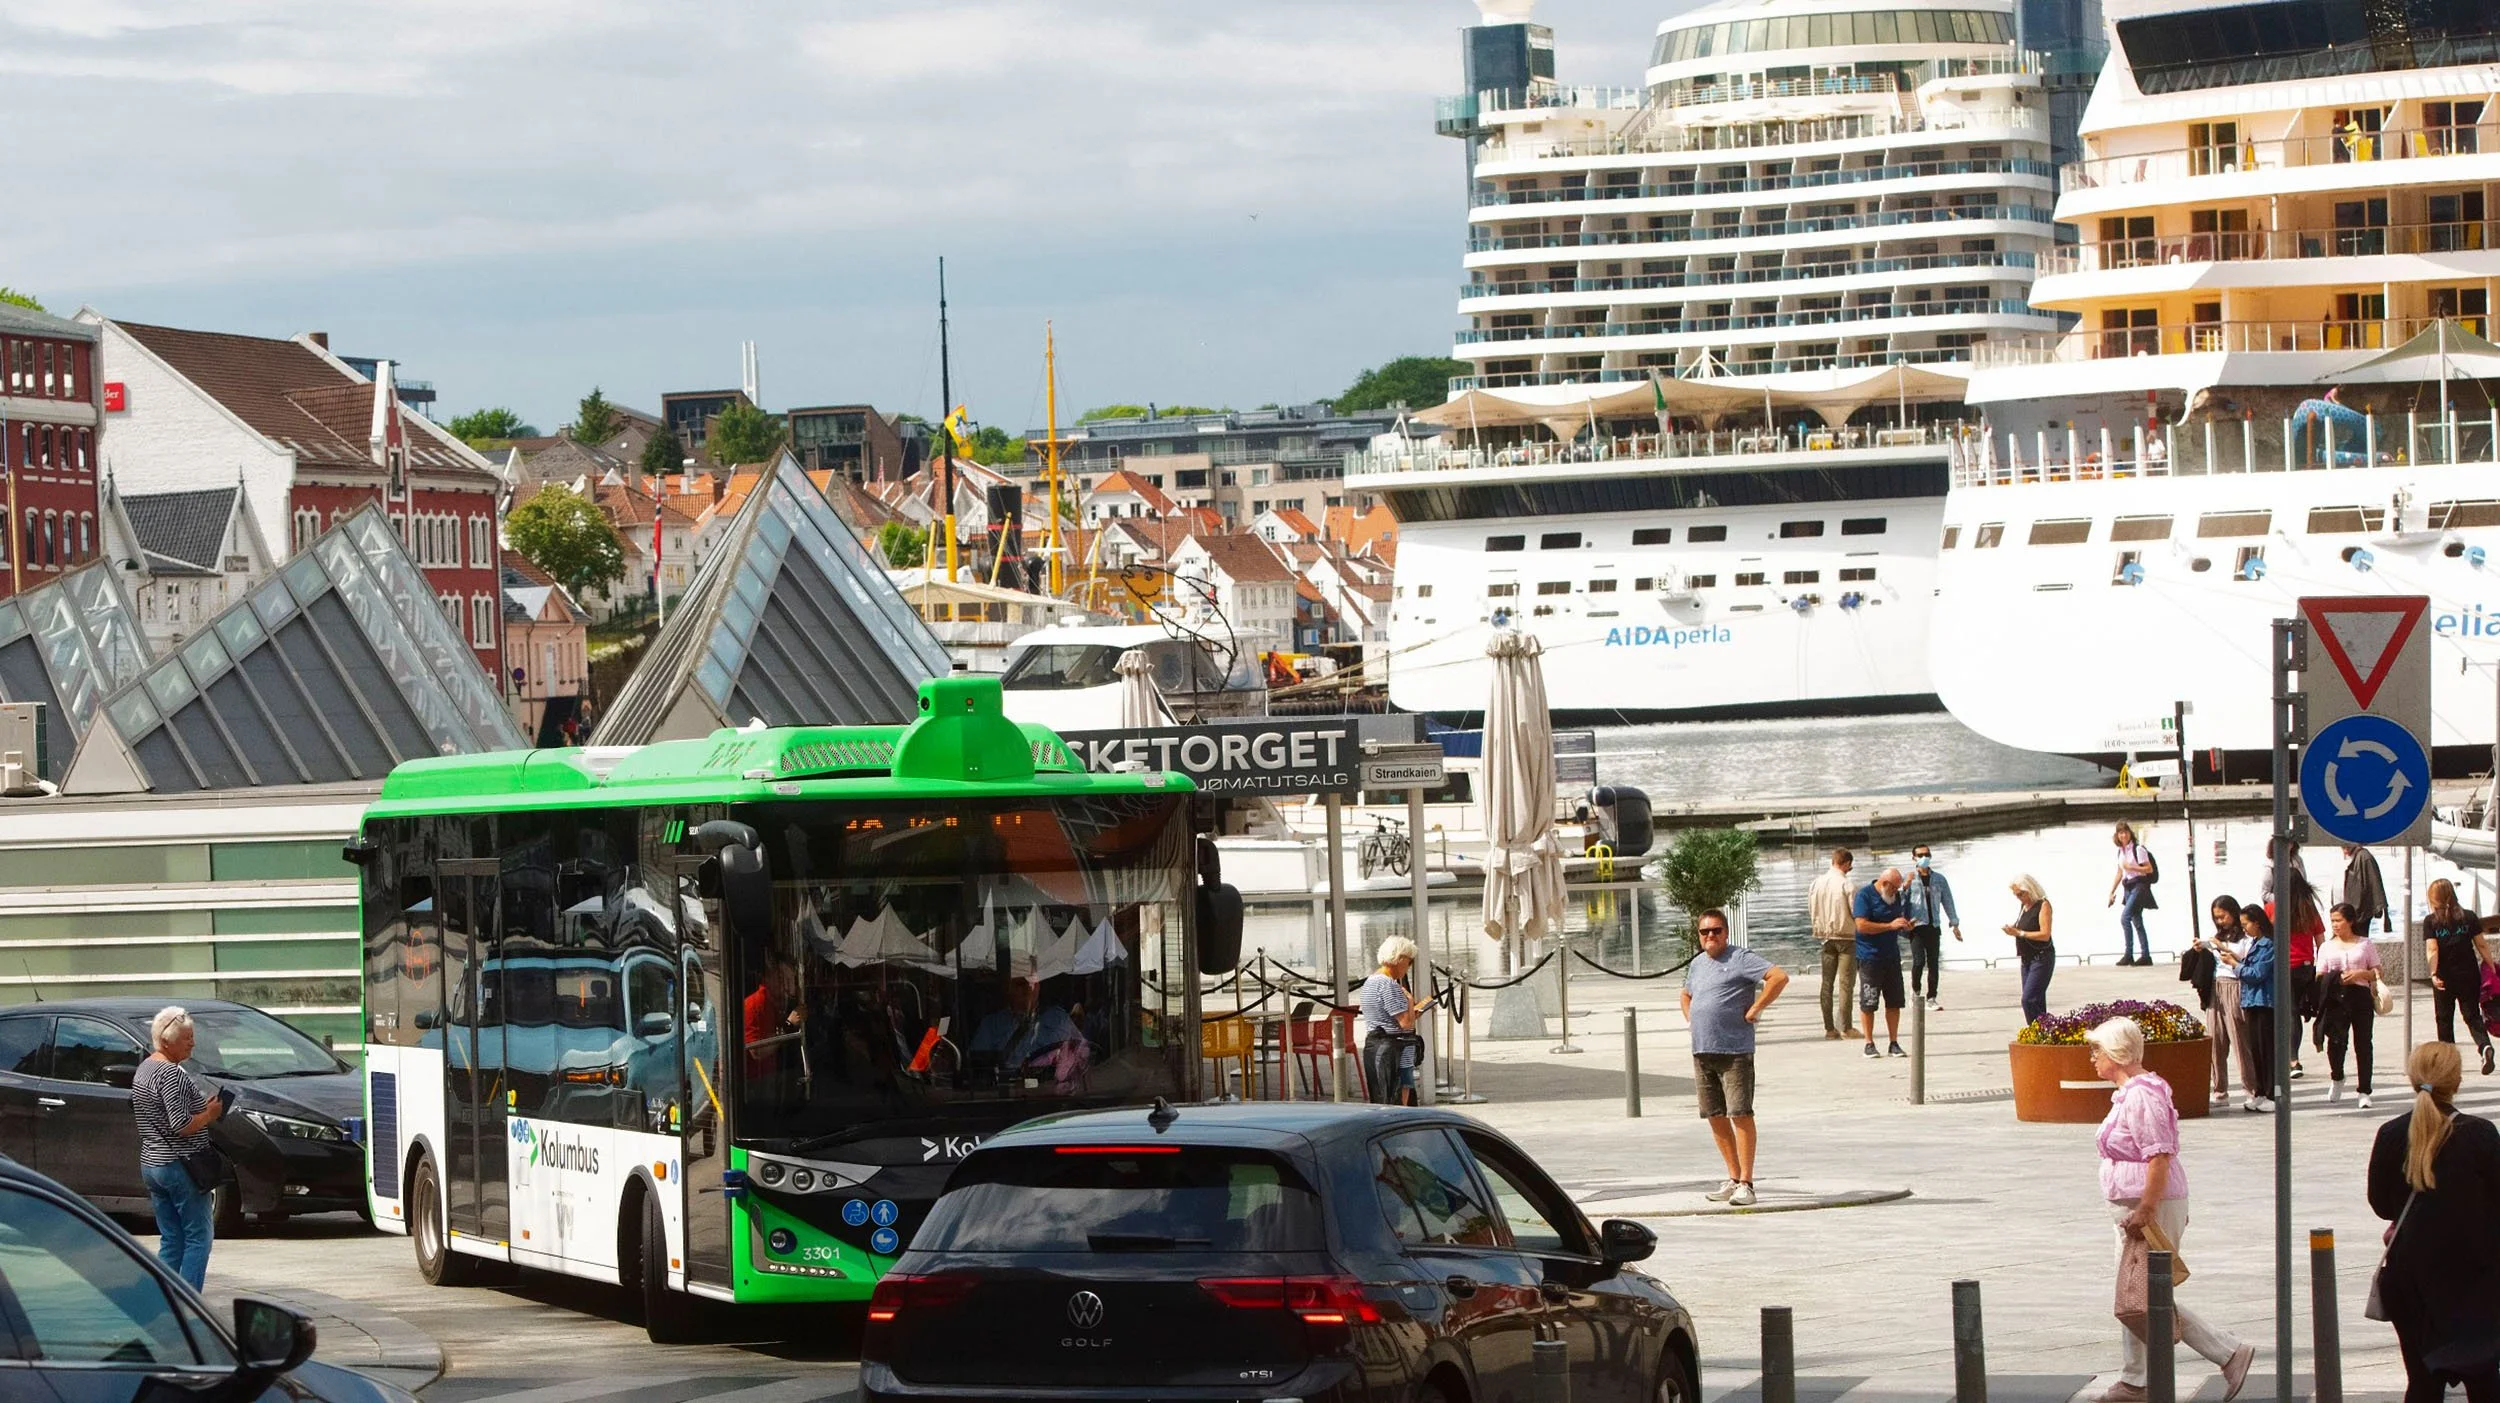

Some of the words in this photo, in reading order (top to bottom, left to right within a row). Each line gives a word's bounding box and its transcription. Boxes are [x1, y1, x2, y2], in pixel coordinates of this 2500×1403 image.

[1605, 624, 1731, 649] AIDAperla
[1375, 767, 1436, 779] Strandkaien
[541, 1129, 599, 1175] Kolumbus
[803, 1247, 840, 1260] 3301
[1061, 1338, 1112, 1347] GOLF
[1240, 1370, 1273, 1379] eTSI
